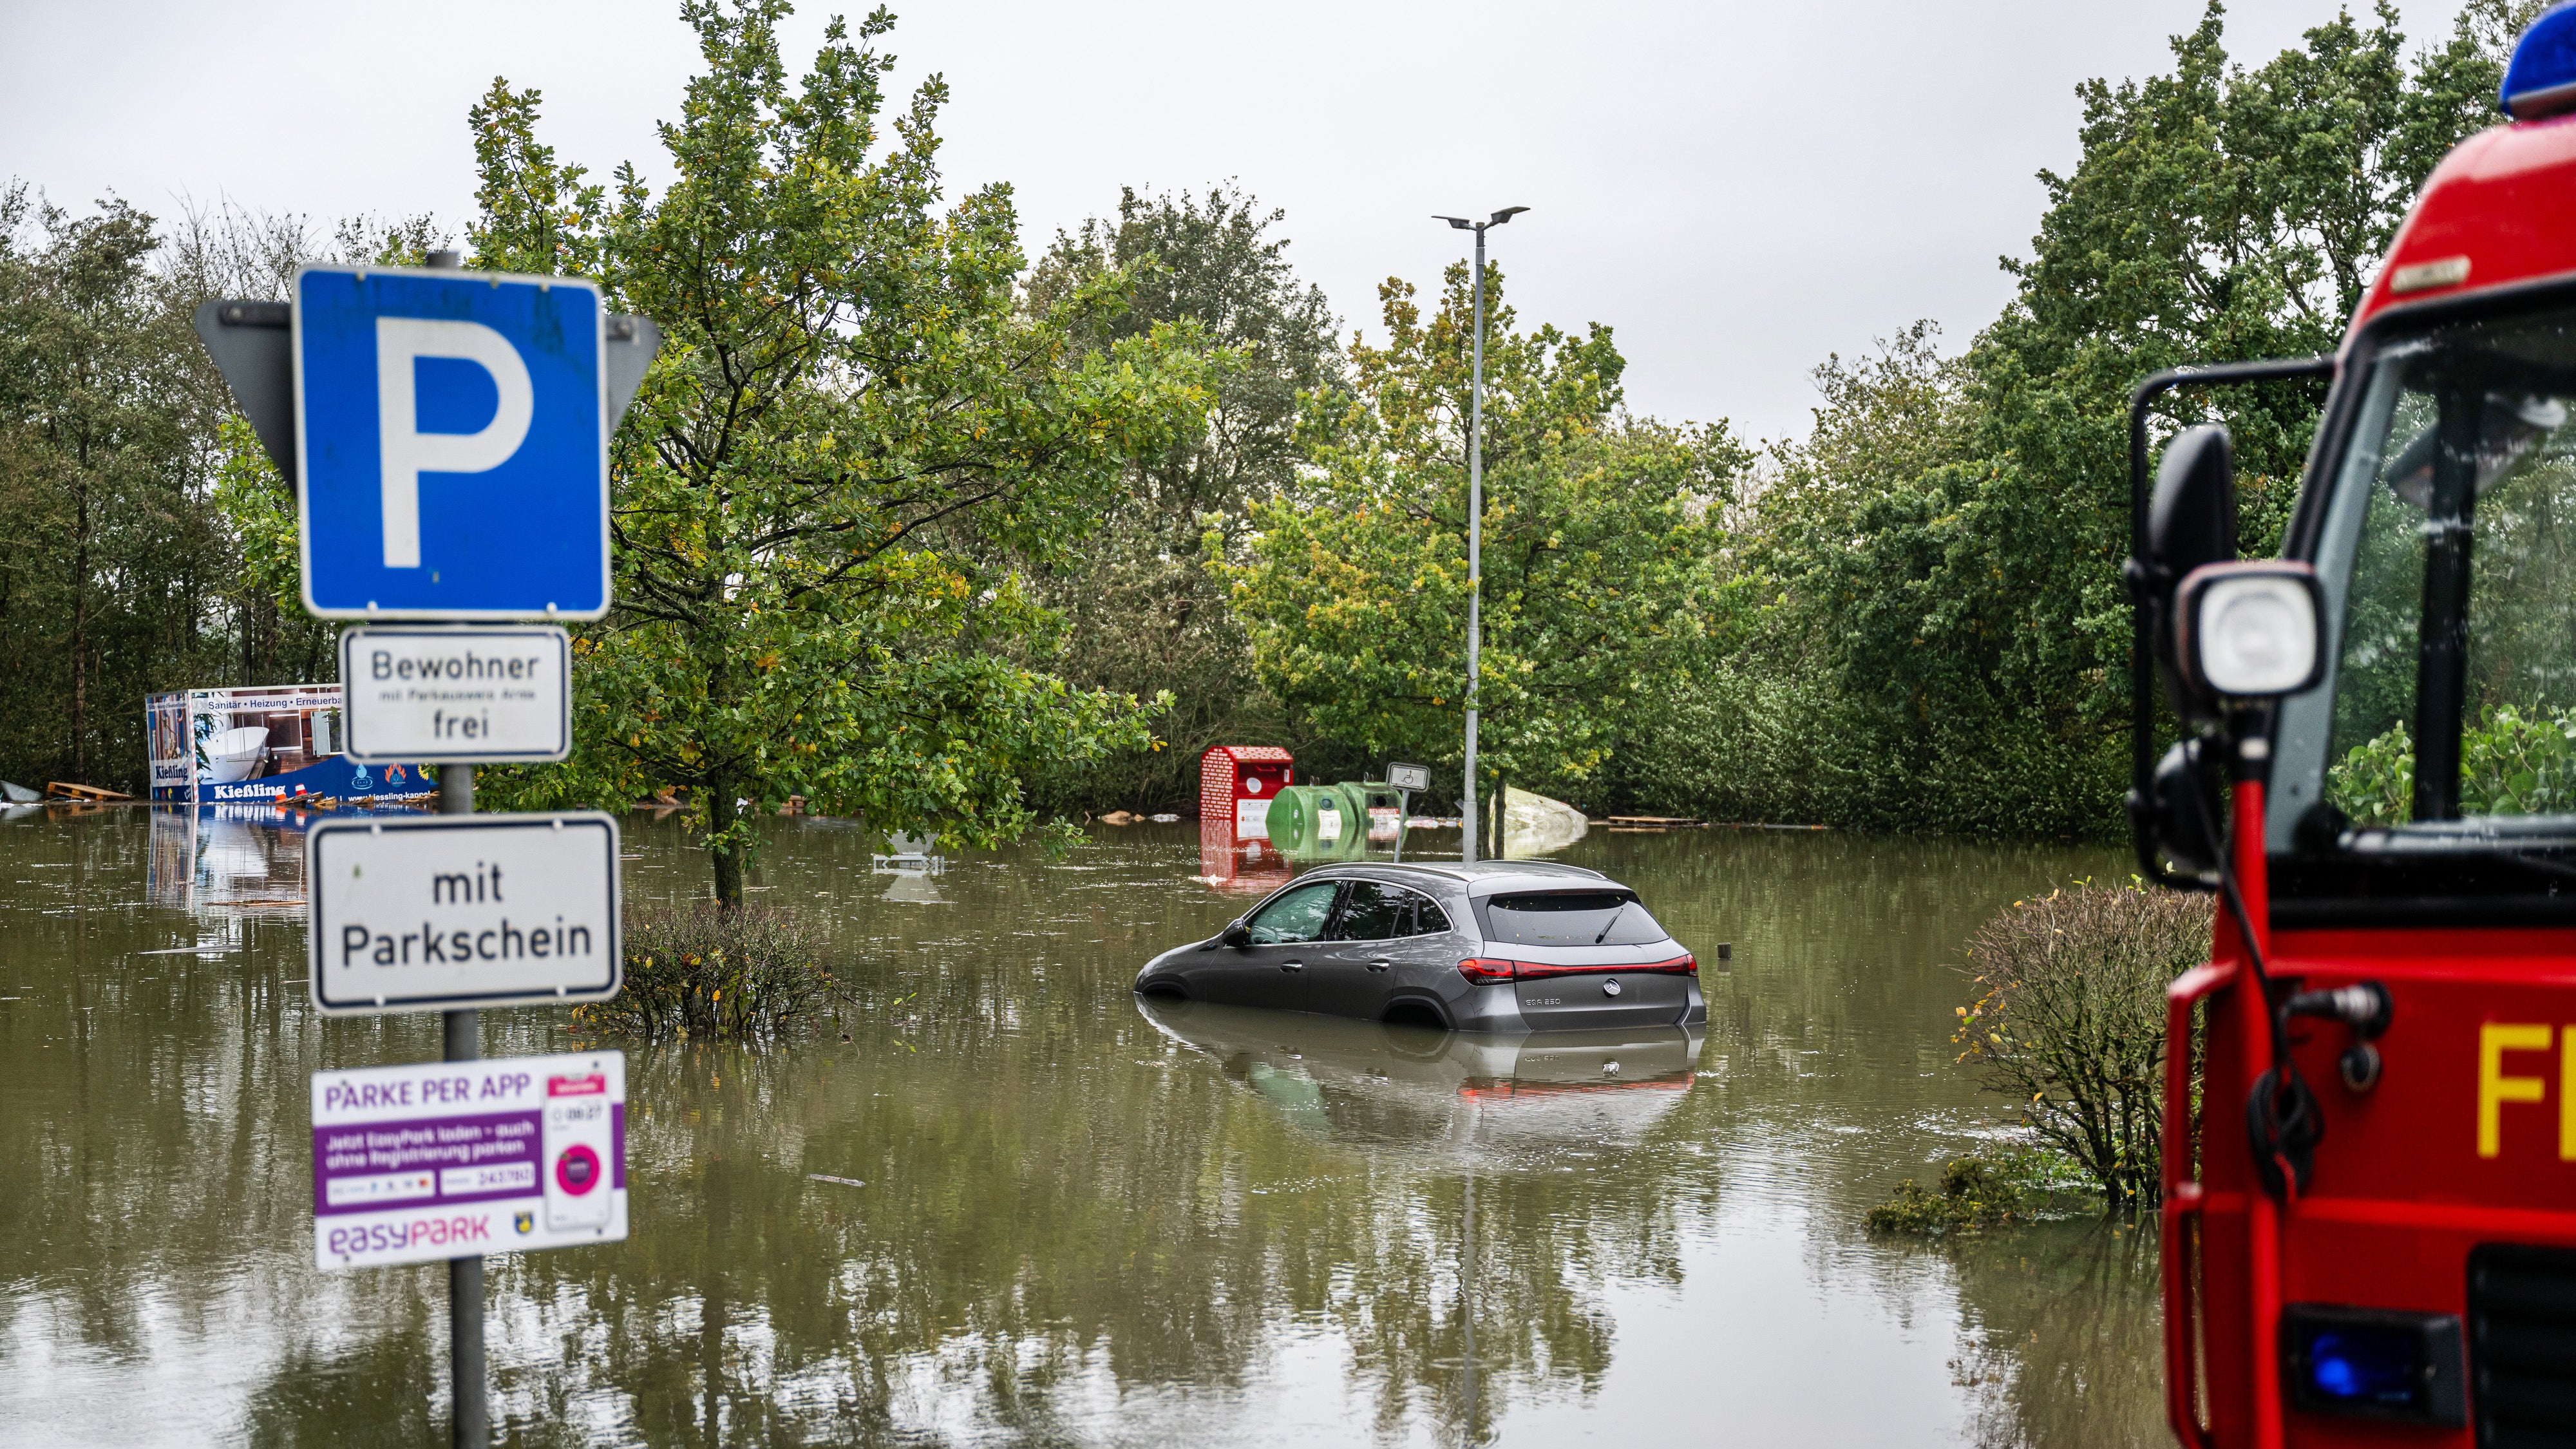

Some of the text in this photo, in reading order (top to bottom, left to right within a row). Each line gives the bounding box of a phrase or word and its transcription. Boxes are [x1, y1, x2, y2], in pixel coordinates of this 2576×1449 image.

[375, 316, 534, 568] P
[372, 650, 540, 680] Bewohner
[208, 700, 241, 710] Sanitär
[250, 697, 287, 709] Heizung
[434, 709, 489, 739] frei
[155, 765, 189, 781] Kießling
[433, 860, 504, 904] mit
[342, 915, 591, 969] Parkschein
[325, 1081, 413, 1111] PARKE
[422, 1077, 471, 1104] PER
[480, 1072, 531, 1099] APP
[2477, 1021, 2576, 1162] F
